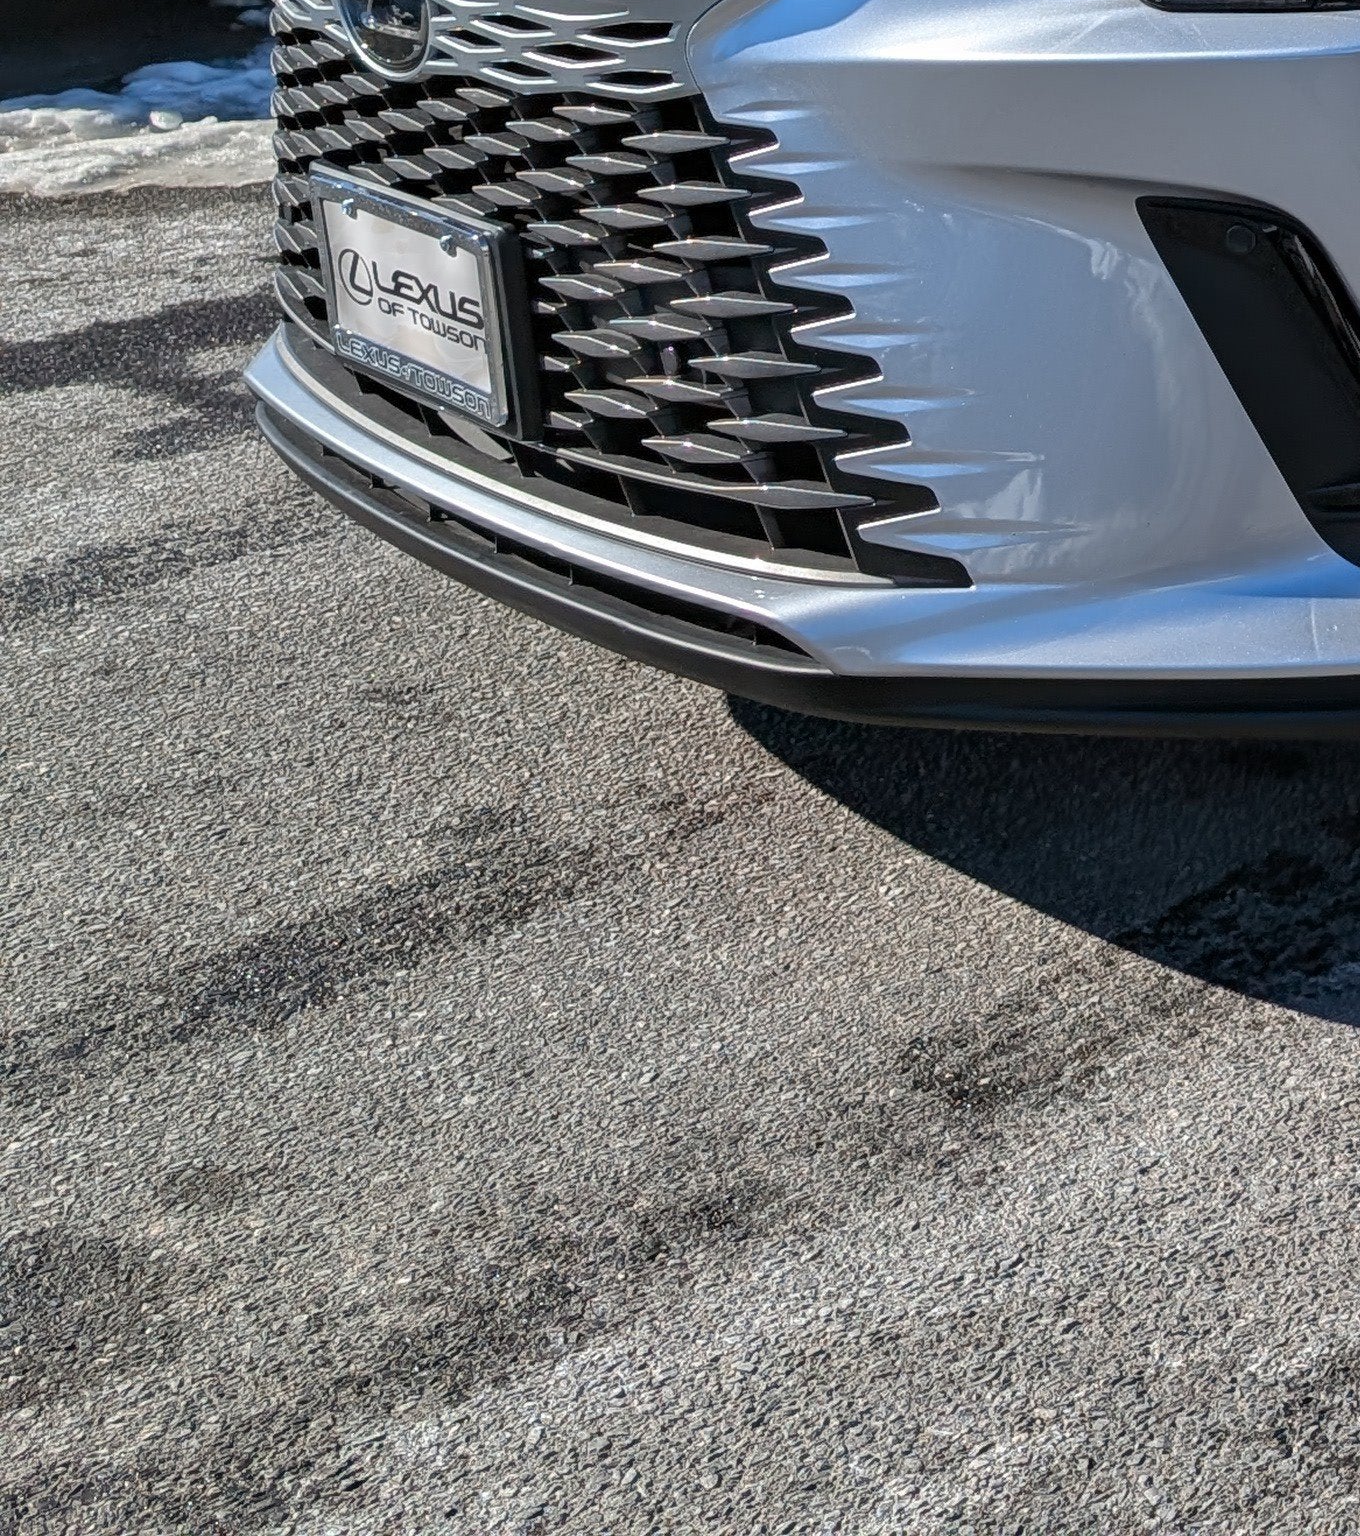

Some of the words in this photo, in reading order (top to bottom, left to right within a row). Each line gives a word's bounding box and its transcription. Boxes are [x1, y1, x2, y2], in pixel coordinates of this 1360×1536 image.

[371, 260, 485, 330] LEXUS
[377, 296, 405, 317] OF
[336, 331, 401, 377] LEXUS
